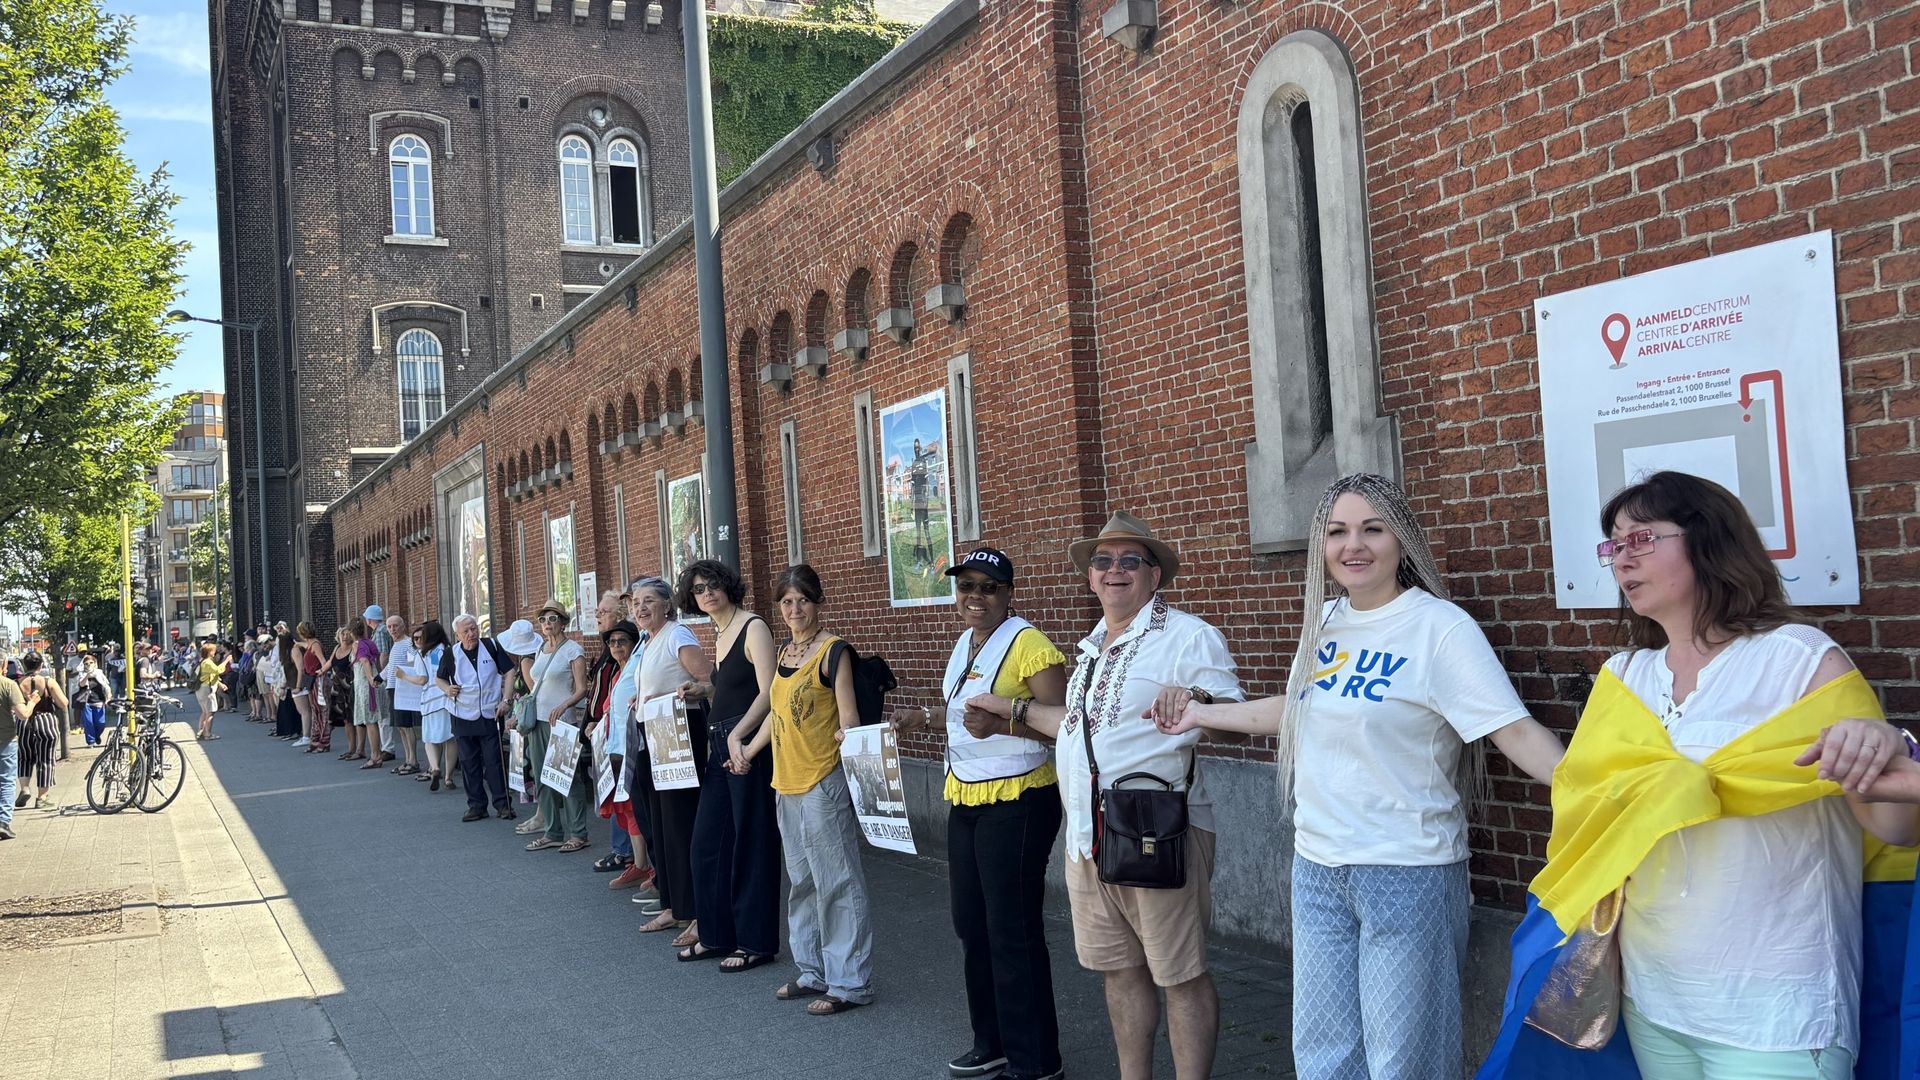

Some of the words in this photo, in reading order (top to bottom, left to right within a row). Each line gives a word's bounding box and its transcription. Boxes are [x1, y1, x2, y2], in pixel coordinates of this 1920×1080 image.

[1636, 324, 1679, 343] CENTRE
[1680, 310, 1744, 334] D'ARRIVÉE
[1616, 387, 1676, 403] Passendaelestraat
[1676, 386, 1684, 394] 2,
[1685, 382, 1704, 393] 1000
[1705, 377, 1732, 390] Brussel
[1636, 379, 1662, 390] Ingang
[1667, 373, 1691, 384] Entrée
[1697, 367, 1731, 379] Entrance
[1597, 409, 1610, 417] Rue
[1611, 406, 1620, 415] de
[1620, 399, 1669, 414] Passchendaele
[1671, 398, 1678, 406] 2,
[1679, 394, 1698, 405] 1000
[1699, 390, 1733, 402] Bruxelles
[962, 551, 1000, 567] DIOR
[1355, 648, 1409, 677] UV
[1340, 675, 1392, 703] RC
[883, 732, 895, 747] We
[885, 758, 898, 769] are
[889, 776, 901, 791] not
[887, 824, 912, 840] DANGER
